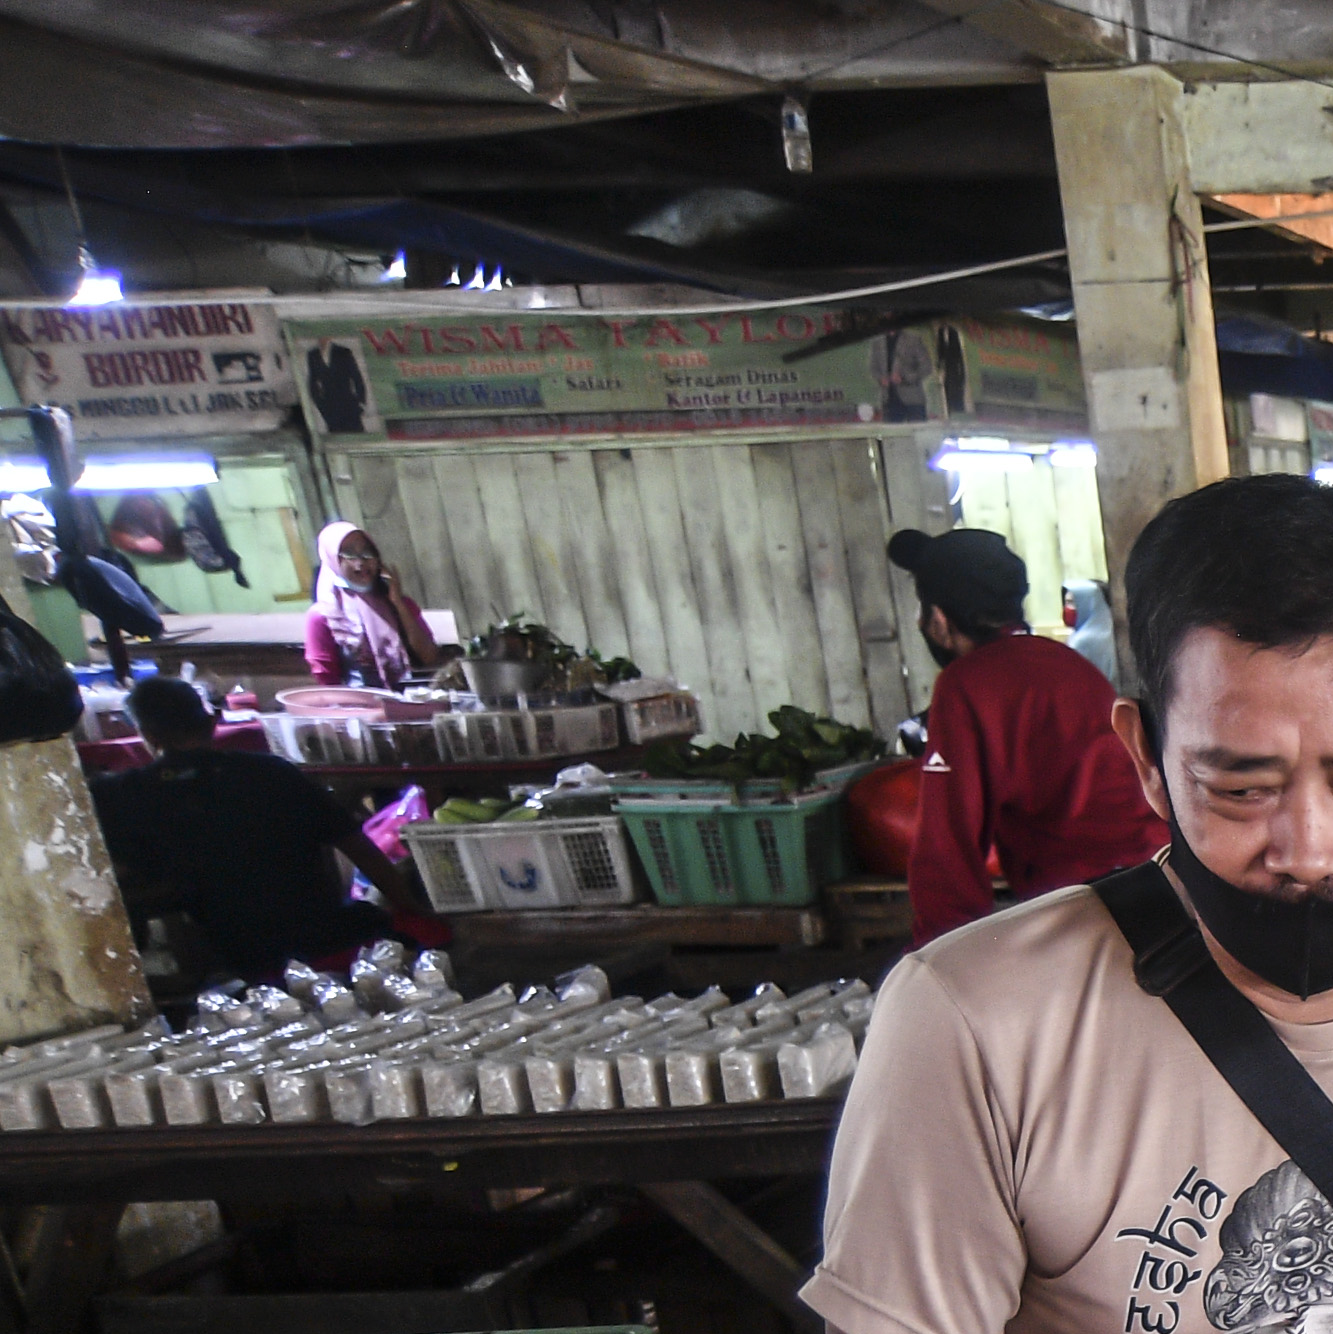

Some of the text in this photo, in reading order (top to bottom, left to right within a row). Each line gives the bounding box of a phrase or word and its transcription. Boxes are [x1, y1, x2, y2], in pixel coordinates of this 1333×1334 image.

[361, 322, 580, 355] WISMA
[83, 349, 208, 387] BORDIR
[748, 368, 798, 385] Dinas
[666, 388, 731, 409] Kantor
[757, 387, 845, 408] Lapangan
